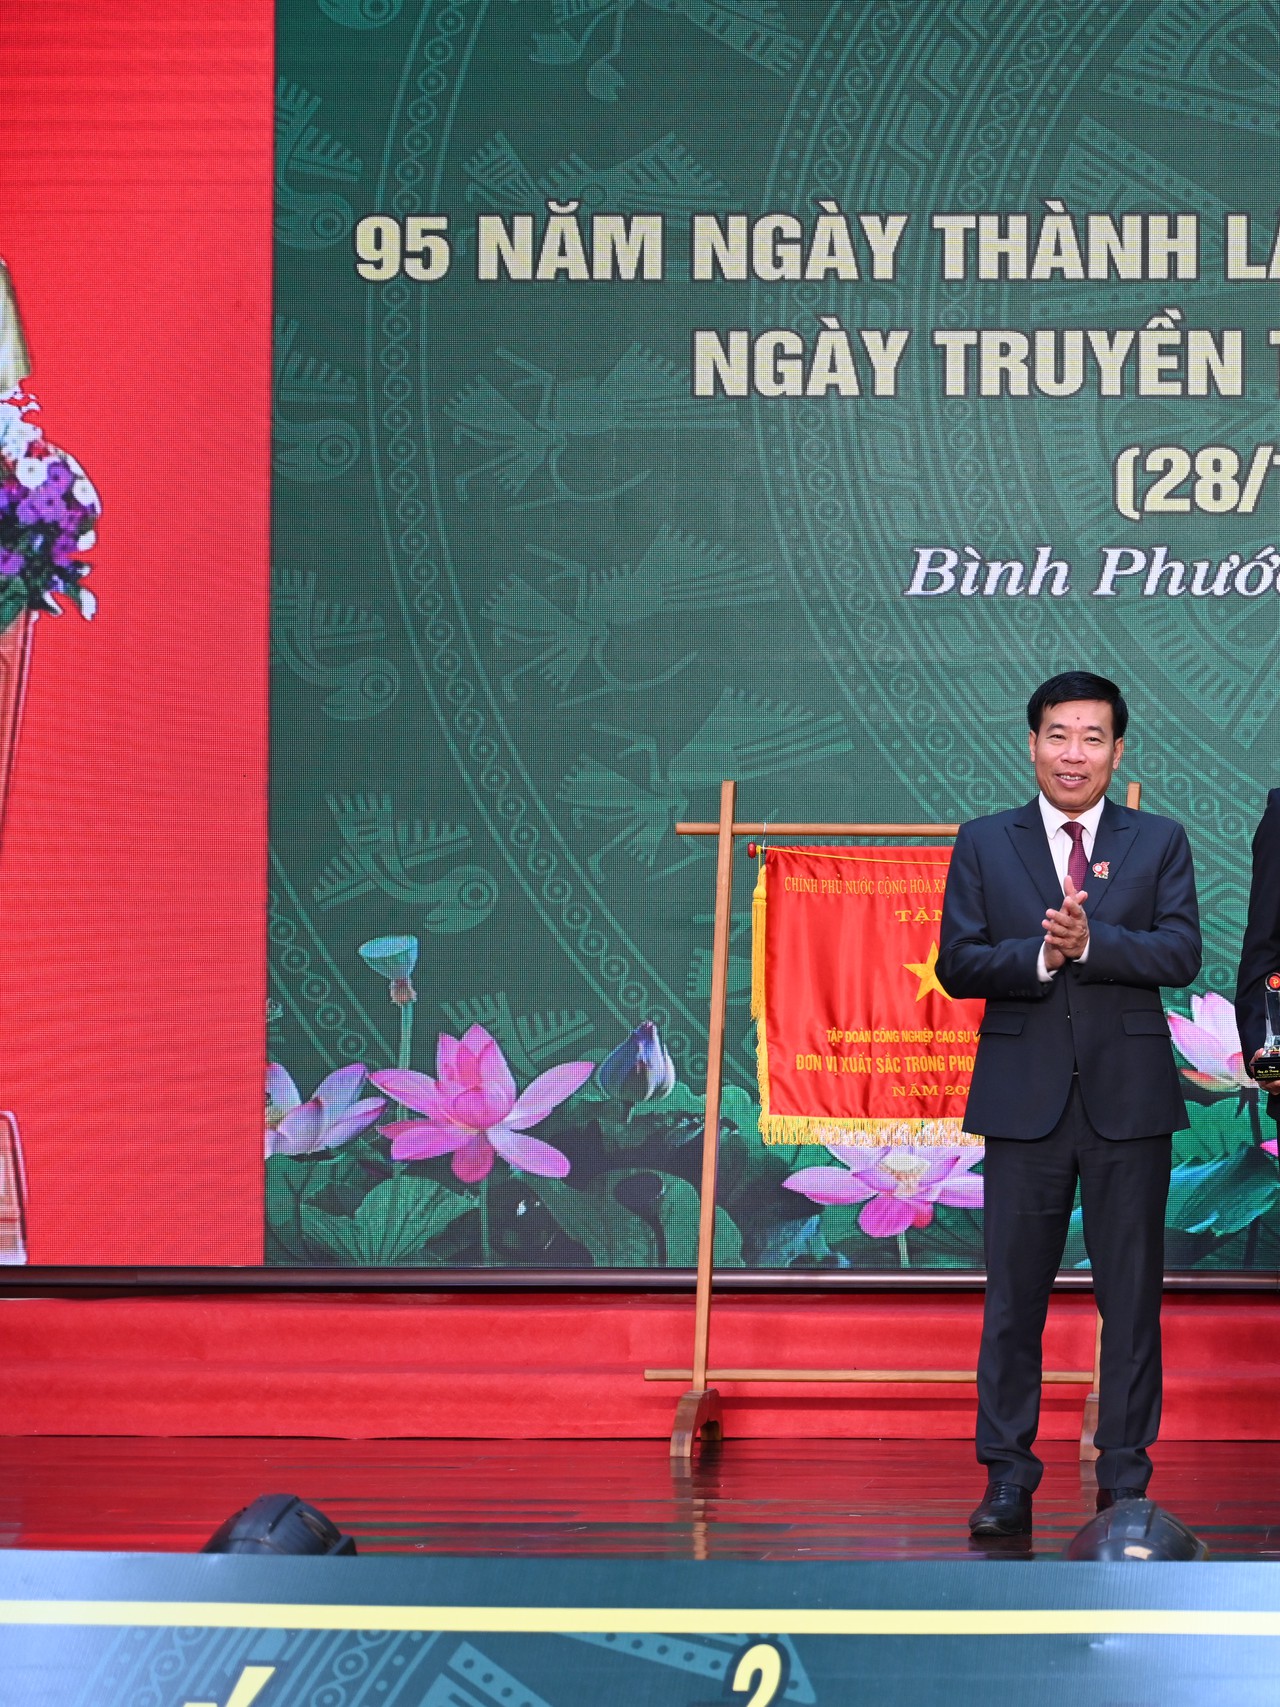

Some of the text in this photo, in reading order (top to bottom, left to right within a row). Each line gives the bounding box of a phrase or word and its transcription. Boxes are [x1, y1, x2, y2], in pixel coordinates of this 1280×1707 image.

[356, 216, 450, 280] 95
[479, 201, 662, 280] NĂM
[694, 201, 907, 281] NGÀY
[933, 200, 1197, 279] THÀNH
[695, 317, 909, 397] NGÀY
[934, 308, 1242, 396] TRUYỀN
[905, 545, 1069, 597] Bình
[784, 874, 818, 893] CHÍNH
[821, 873, 843, 894] PHỦ
[845, 876, 875, 895] NƯỚC
[877, 876, 907, 899] CỘNG
[826, 1027, 843, 1046] TẬP
[845, 1028, 872, 1043] ĐOÀN
[872, 1027, 900, 1043] CÔNG
[901, 1027, 934, 1046] NGHIỆP
[935, 1030, 955, 1043] CAO
[957, 1030, 970, 1044] SU
[796, 1052, 976, 1076] ĐƠN VỊ XUẤT SẮC TRONG PHO
[891, 1082, 939, 1097] NĂM
